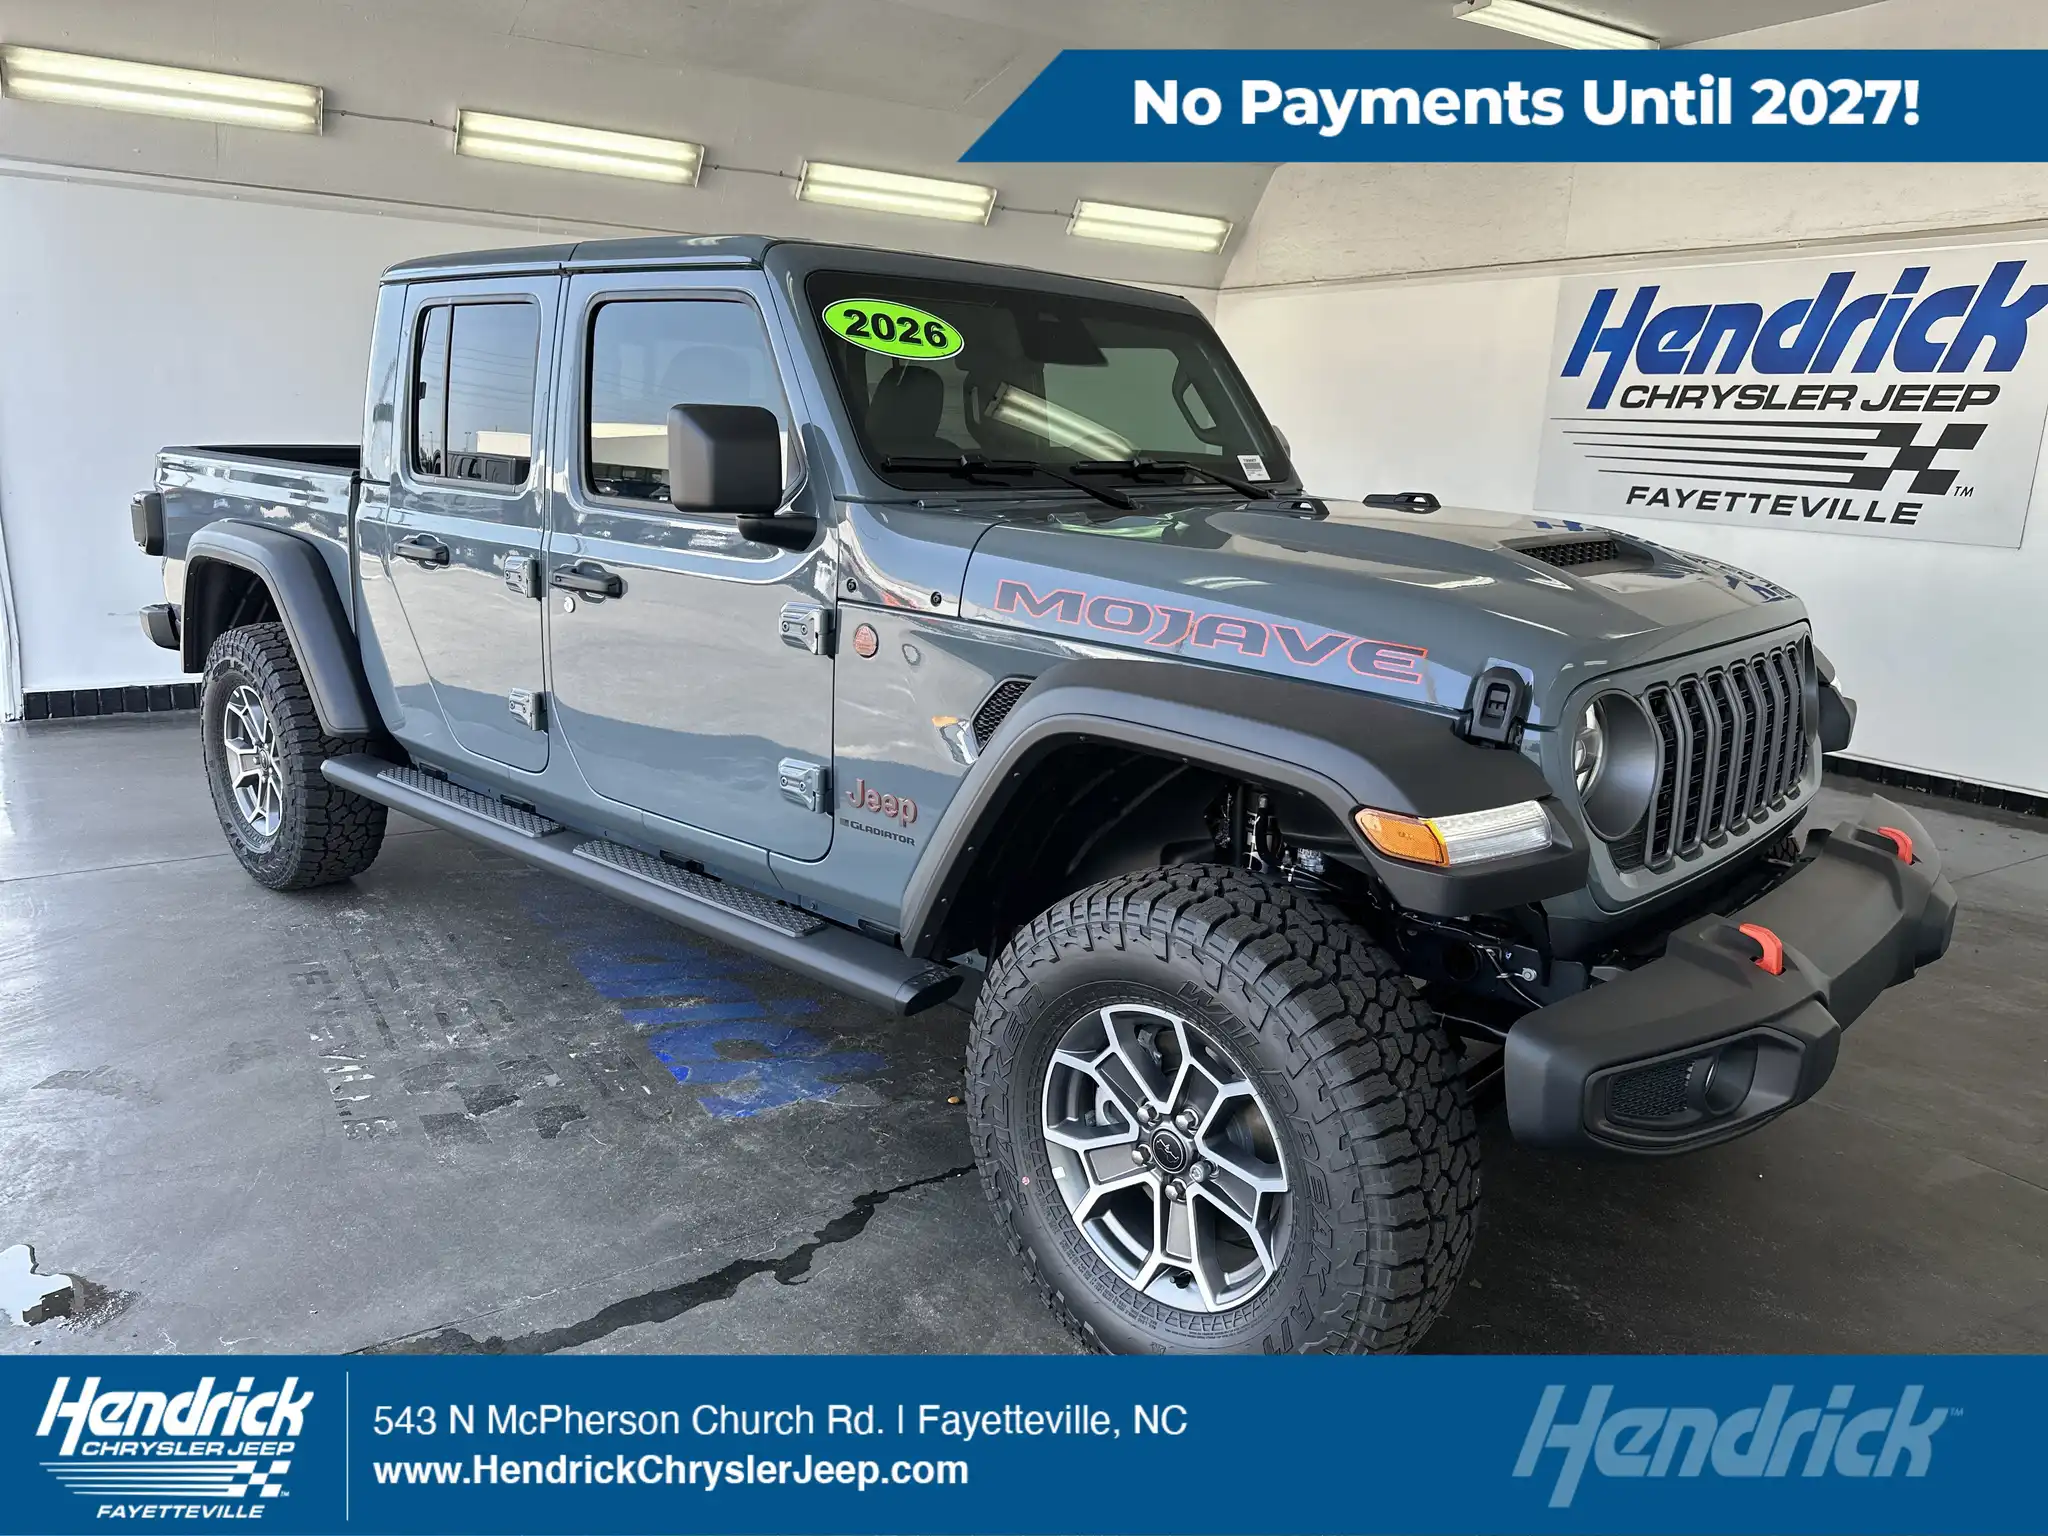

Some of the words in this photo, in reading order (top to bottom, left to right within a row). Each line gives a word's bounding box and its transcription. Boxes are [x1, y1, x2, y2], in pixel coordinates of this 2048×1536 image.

[843, 308, 949, 349] 2026
[1560, 260, 2048, 410] Hendrick
[1619, 384, 1859, 412] CHRYSLER
[1861, 384, 2001, 413] JEEP
[1625, 485, 1924, 526] FAYETTEVILLE
[994, 578, 1428, 685] MOJAVE
[845, 777, 918, 828] Jeep
[849, 820, 916, 847] GLADIATOR
